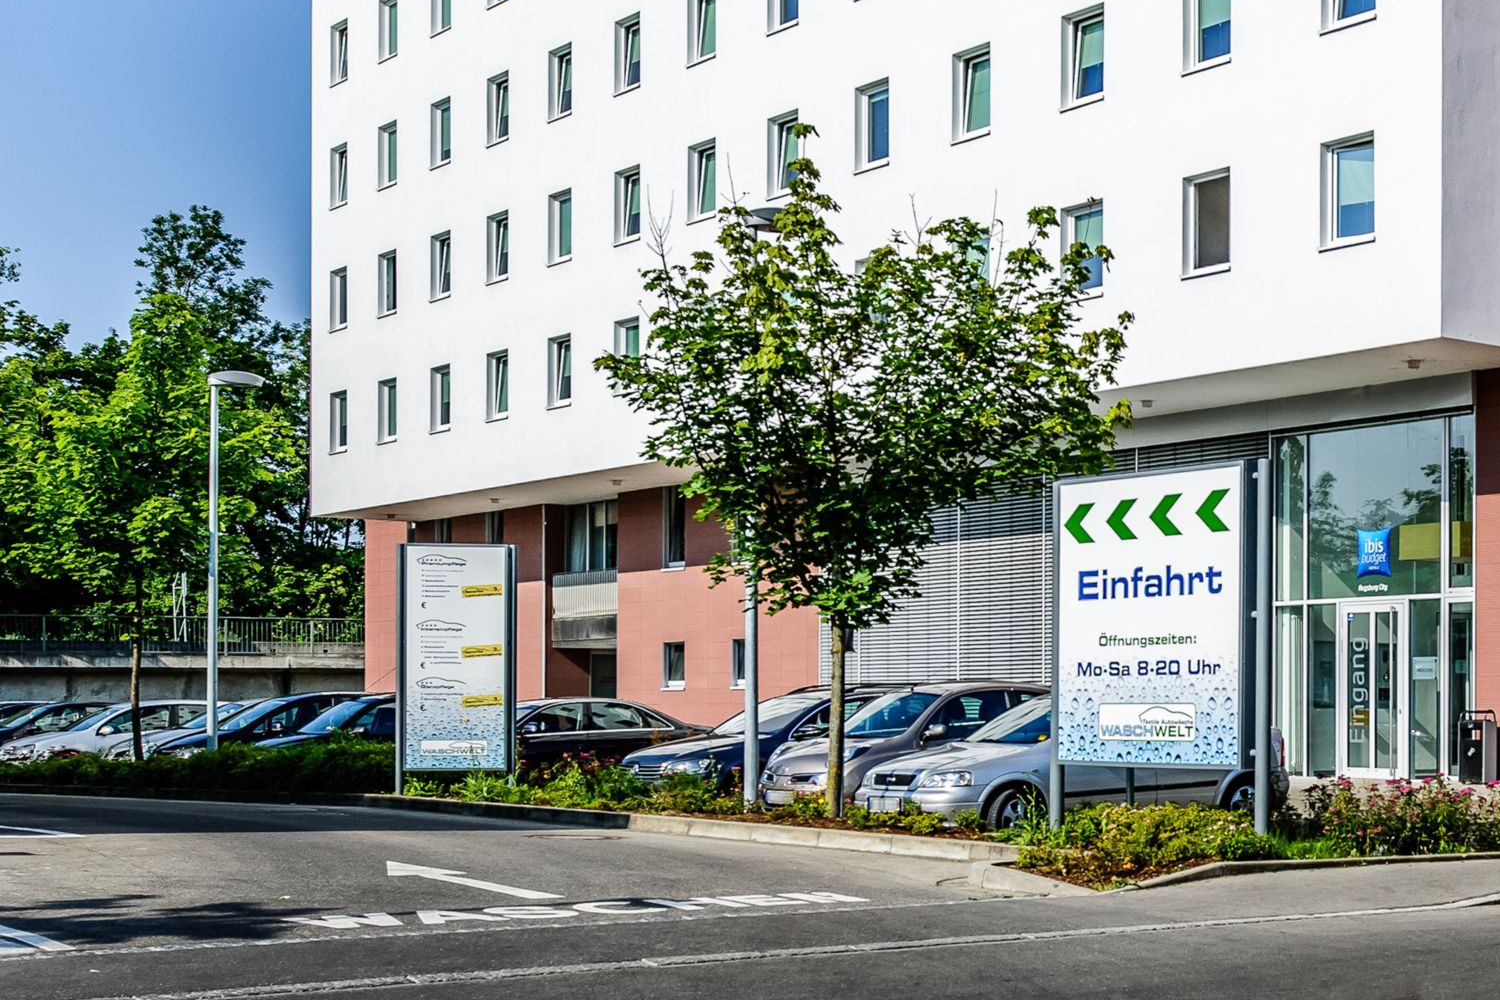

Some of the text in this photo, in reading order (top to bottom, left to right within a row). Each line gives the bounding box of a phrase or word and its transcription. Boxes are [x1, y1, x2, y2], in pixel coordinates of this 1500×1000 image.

[1364, 538, 1384, 554] ibis
[1361, 552, 1387, 565] budget
[1078, 565, 1223, 601] Einfahrt
[1099, 632, 1197, 648] Öffnungszeiten:
[1188, 659, 1221, 675] Uhr
[1349, 637, 1369, 743] Eingang
[1100, 724, 1194, 738] WASCHWELT
[281, 891, 871, 929] WASCHEN
